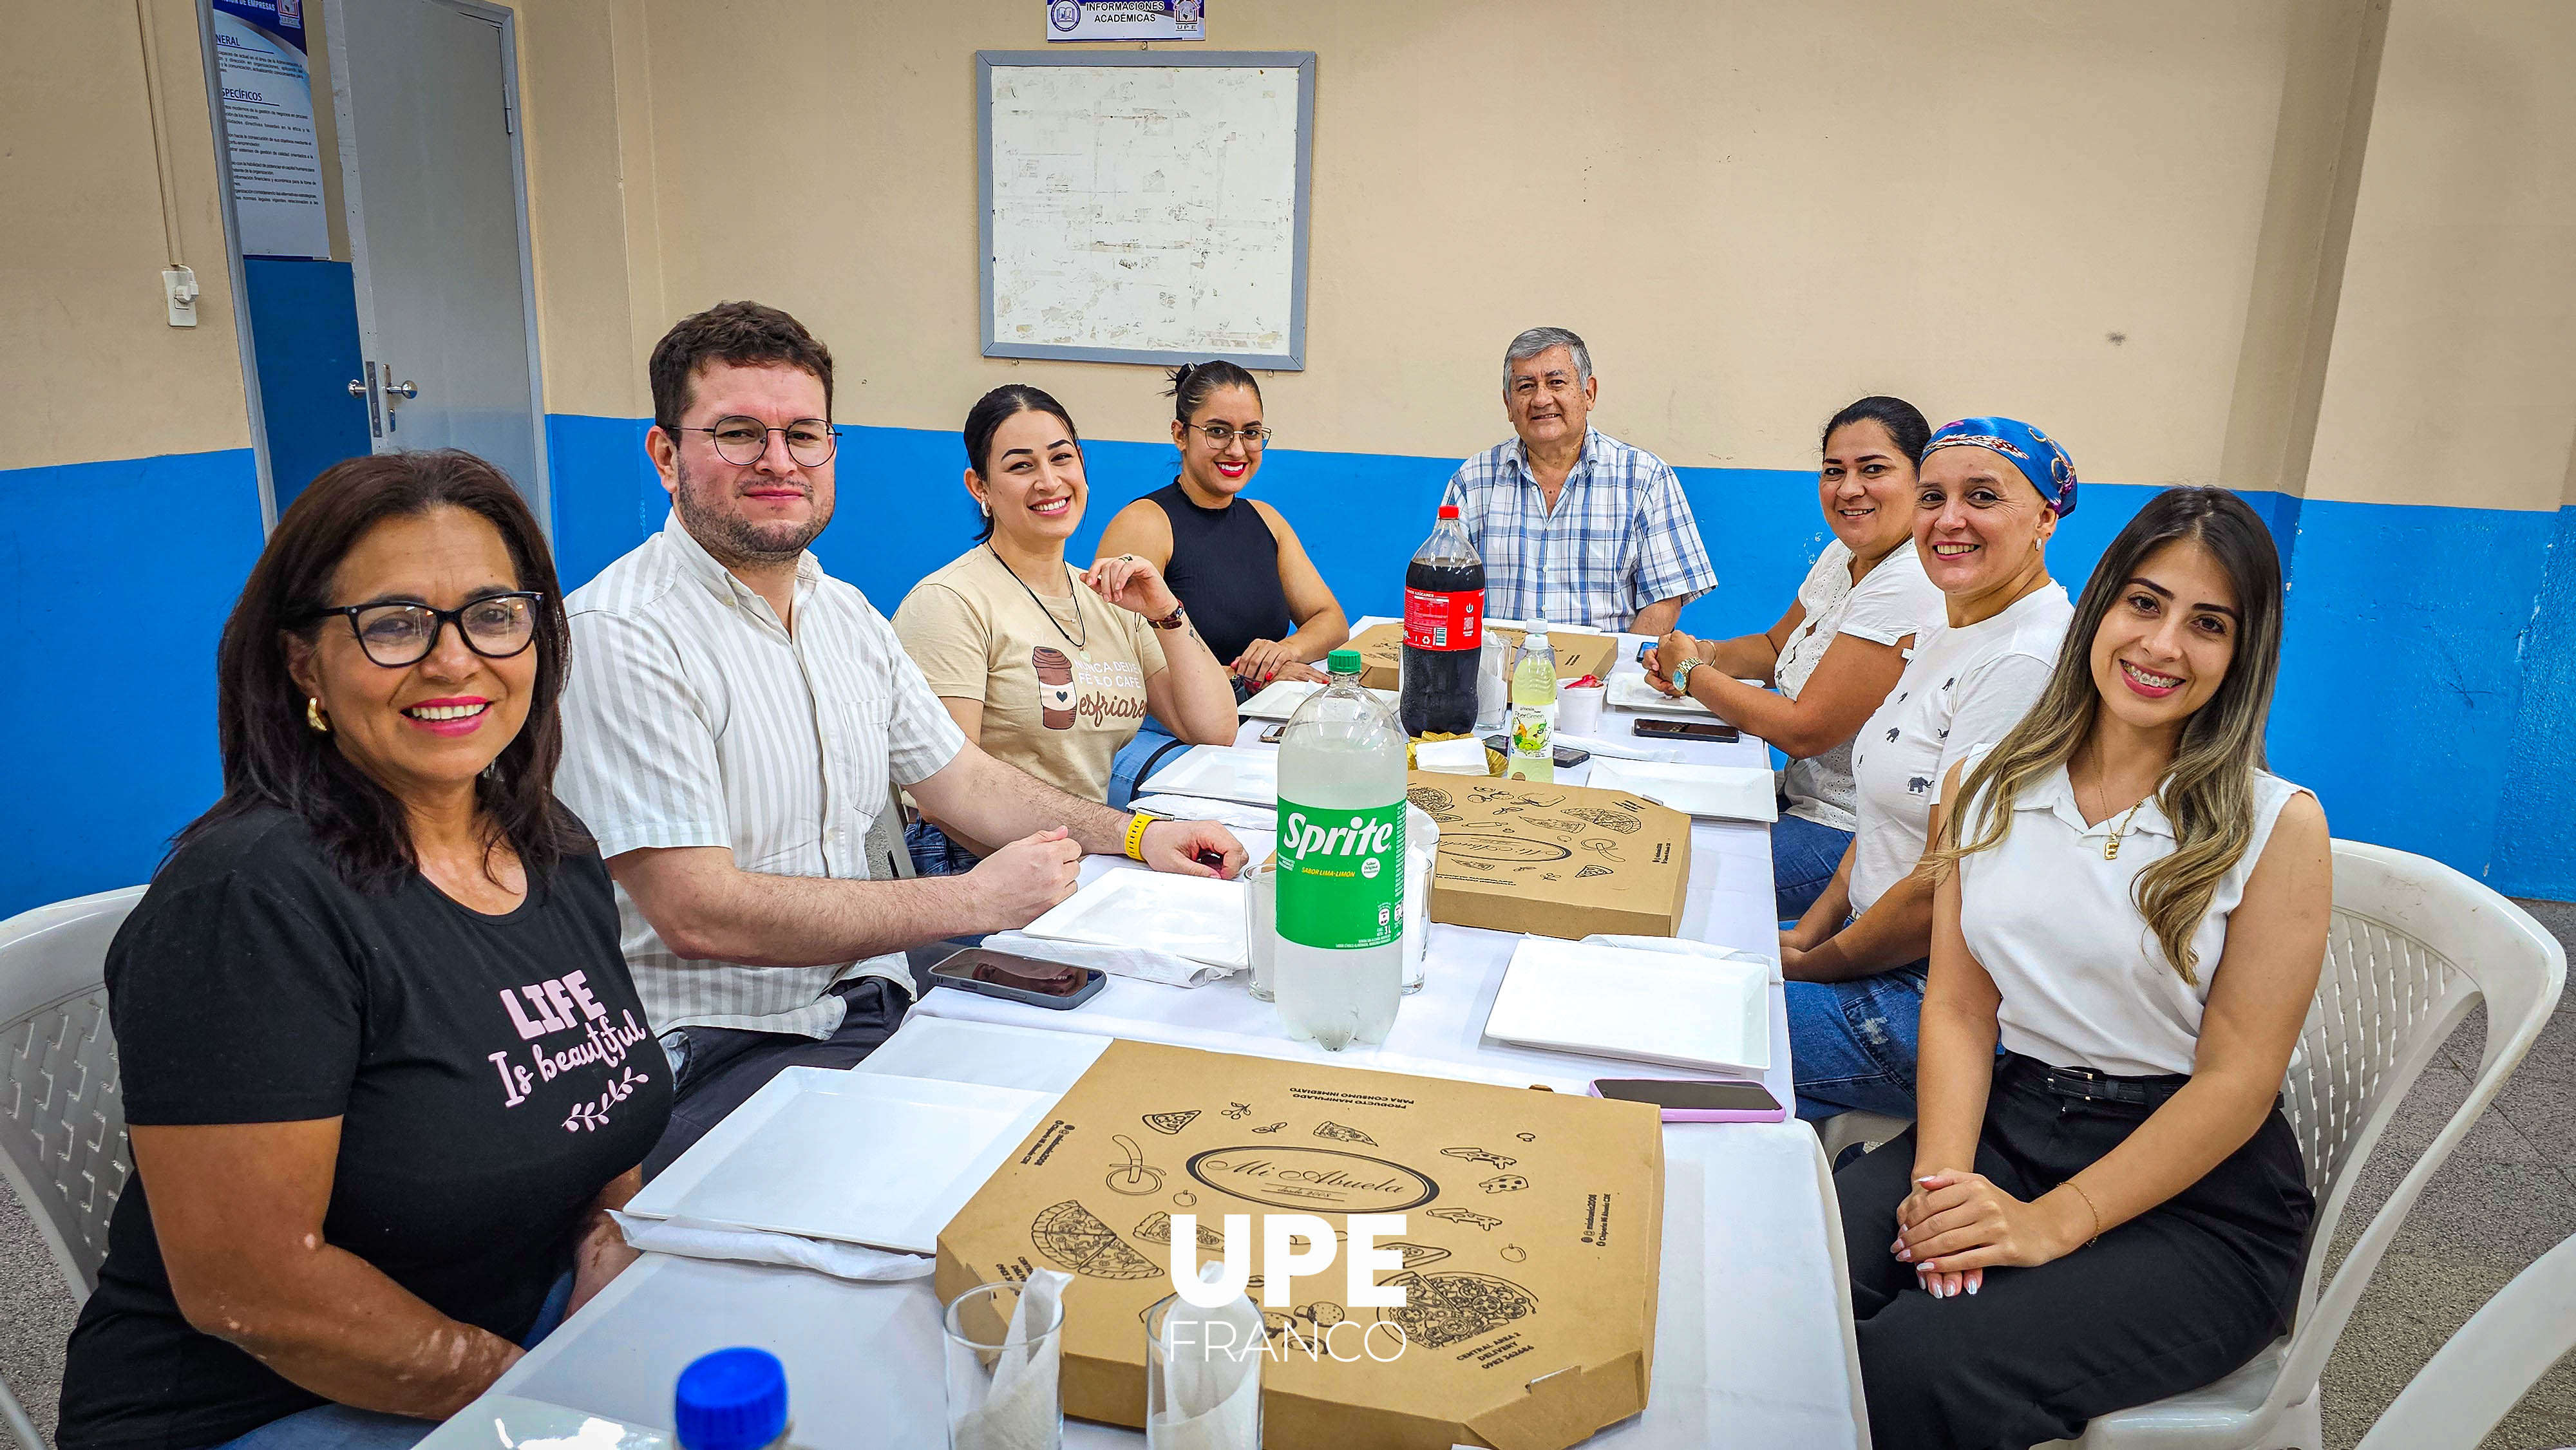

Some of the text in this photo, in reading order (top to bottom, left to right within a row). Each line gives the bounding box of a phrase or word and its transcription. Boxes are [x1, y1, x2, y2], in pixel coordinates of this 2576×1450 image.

[247, 0, 276, 12] EMPRESAS
[1086, 1, 1164, 11] INFORMACIONES
[1094, 12, 1156, 23] ACADÉMICAS
[216, 34, 240, 46] NERAL
[222, 88, 263, 102] SPECÍFICOS
[1073, 659, 1113, 673] NUNCA
[1103, 676, 1113, 688] O
[1079, 691, 1146, 728] esfriare
[1283, 812, 1394, 860] Sprite
[1302, 866, 1320, 875] SABOR
[499, 969, 607, 1040] LIFE
[488, 1008, 647, 1108] Is beautiful
[1289, 1088, 1340, 1097] INMEDIATO
[1341, 1093, 1388, 1101] CONSUMO
[1293, 1093, 1406, 1109] PRODUCTO MANIPULADO
[1206, 1159, 1405, 1194] Mi Abuela
[1456, 1343, 1493, 1361] CENTRAL
[1493, 1335, 1516, 1345] AREA
[1477, 1341, 1518, 1361] DELIVERY
